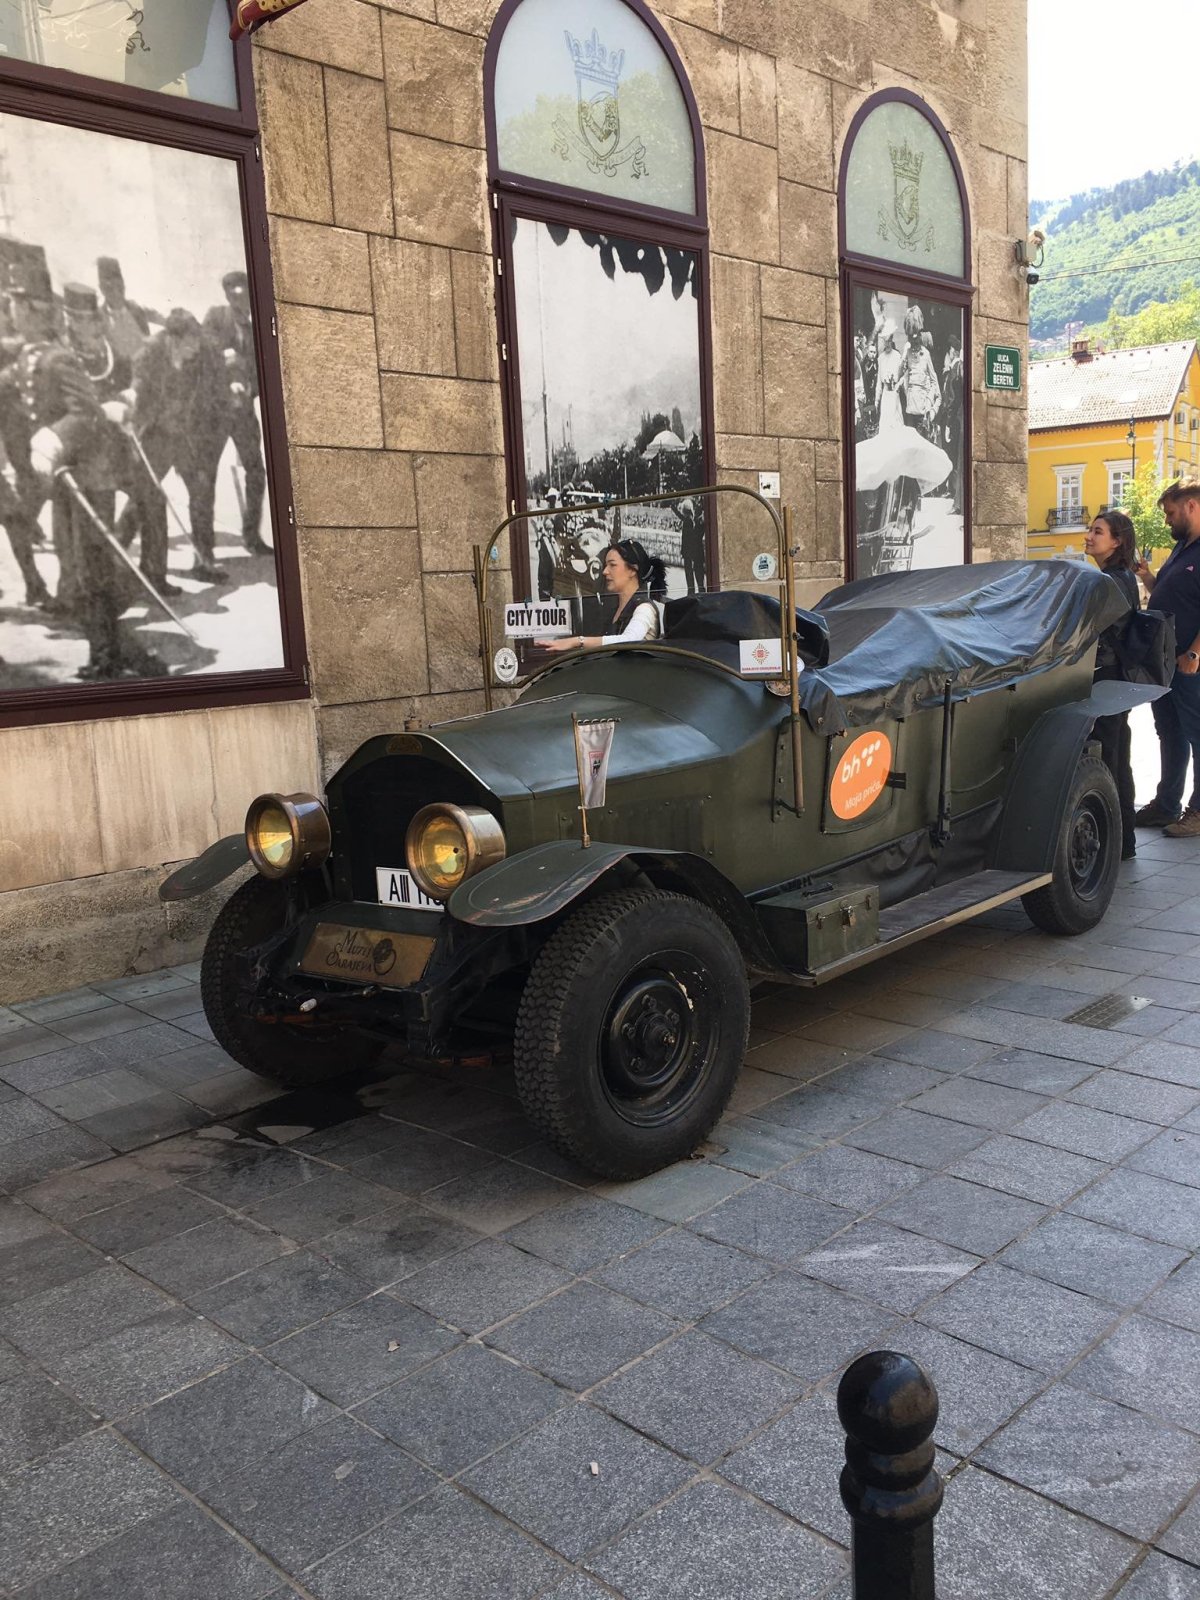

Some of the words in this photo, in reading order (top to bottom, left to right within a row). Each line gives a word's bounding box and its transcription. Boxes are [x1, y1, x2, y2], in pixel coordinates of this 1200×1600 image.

[507, 609, 532, 626] CITY
[535, 608, 566, 626] TOUR
[845, 793, 862, 809] Moja
